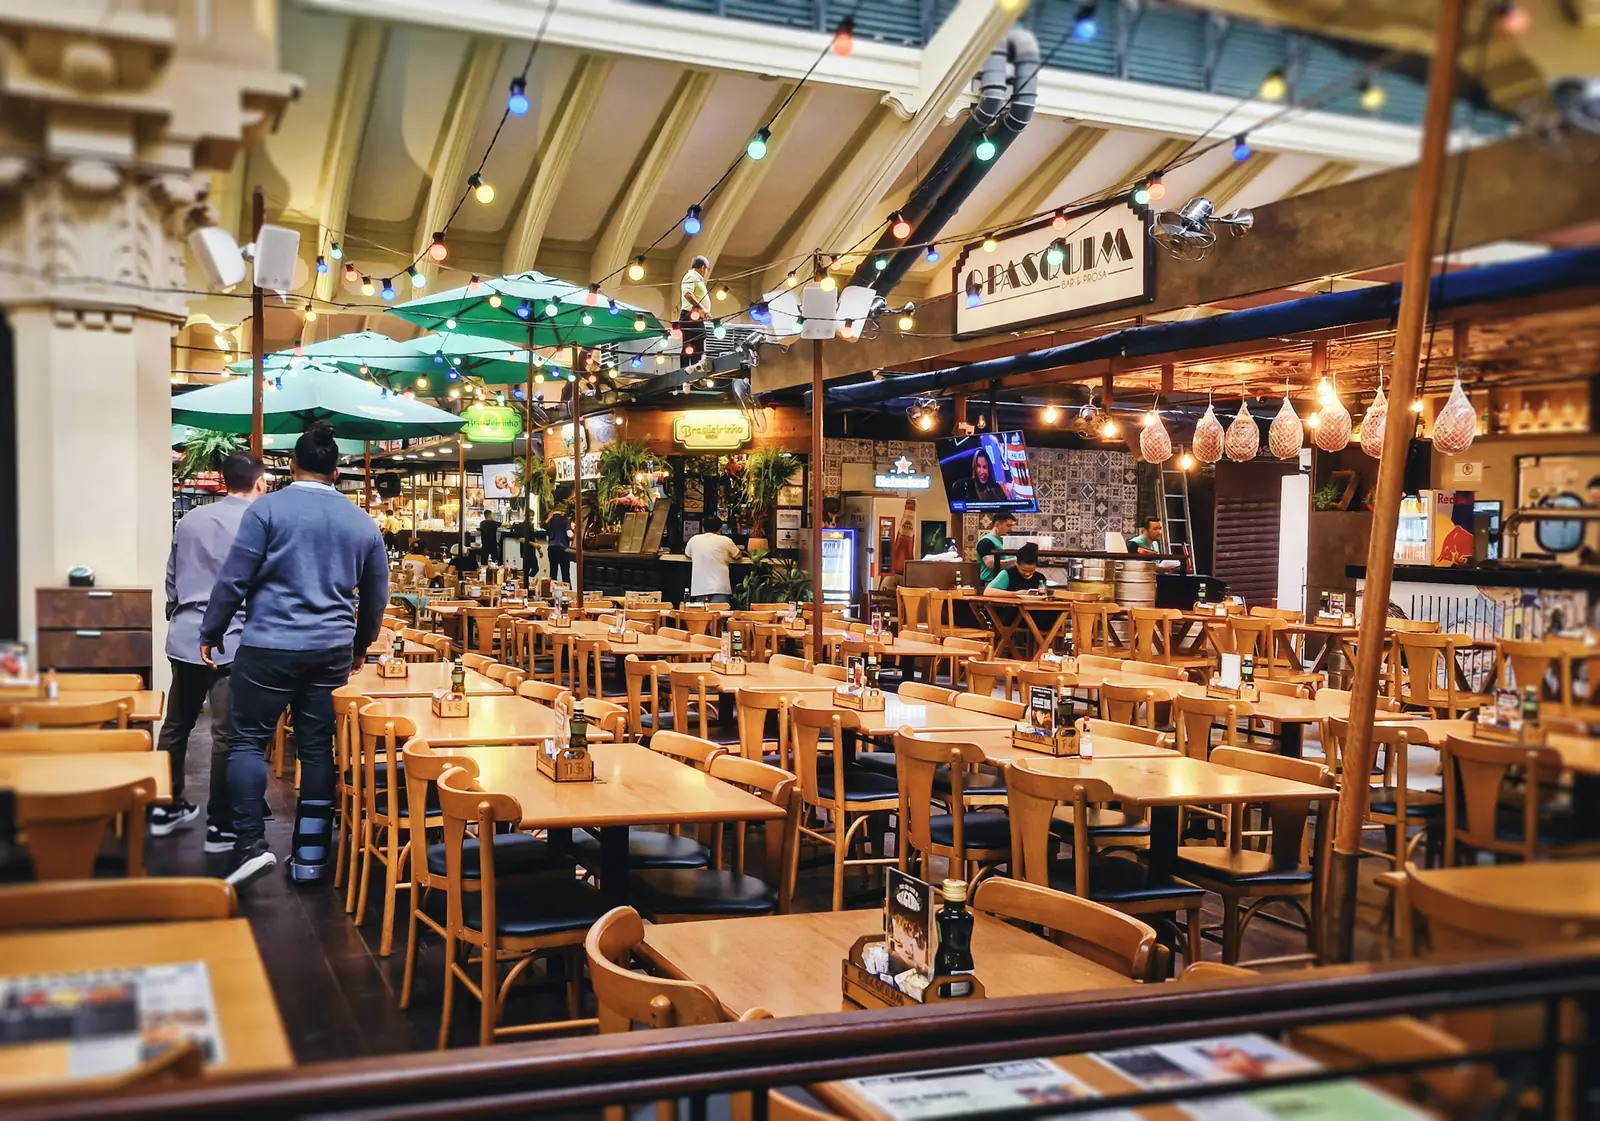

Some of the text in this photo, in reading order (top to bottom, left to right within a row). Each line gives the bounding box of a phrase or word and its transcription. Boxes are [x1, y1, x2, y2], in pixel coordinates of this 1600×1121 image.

[987, 227, 1134, 295] PASQUIM
[1061, 280, 1075, 290] BAR
[1083, 270, 1108, 284] PROSA
[680, 424, 744, 438] Brasileirinho
[874, 474, 931, 489] Heineken
